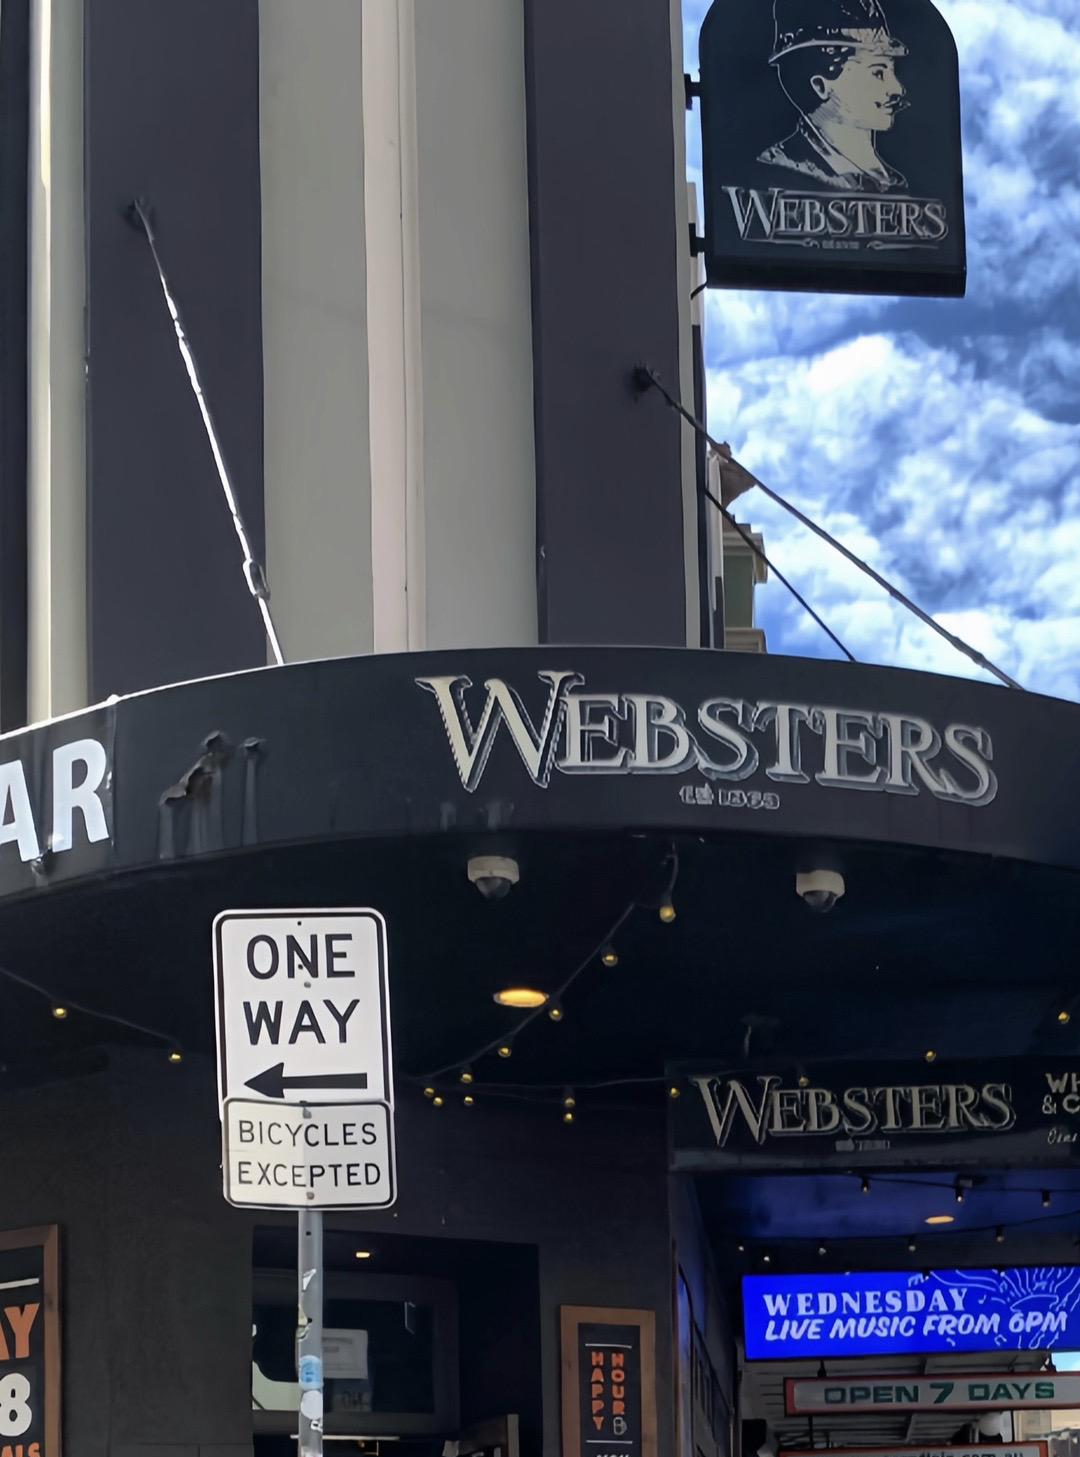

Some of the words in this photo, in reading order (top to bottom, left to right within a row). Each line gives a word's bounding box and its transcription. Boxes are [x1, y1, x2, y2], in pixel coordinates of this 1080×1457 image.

[721, 185, 949, 241] WEBSTERS
[415, 670, 998, 808] WEBSTERS
[246, 933, 356, 980] ONE
[242, 999, 360, 1046] WAY
[692, 1075, 1017, 1148] WEBSTERS
[1042, 1094, 1057, 1115] &
[238, 1120, 378, 1148] BICYCLES
[236, 1162, 381, 1189] EXCEPTED
[763, 1287, 968, 1316] WEDNESDAY
[764, 1317, 824, 1341] LIVE
[829, 1315, 915, 1340] MUSIC
[922, 1312, 999, 1337] FROM
[1008, 1310, 1068, 1334] 6PM
[824, 1385, 919, 1405] OPEN
[930, 1382, 955, 1404] 7
[968, 1381, 1055, 1400] DAYS
